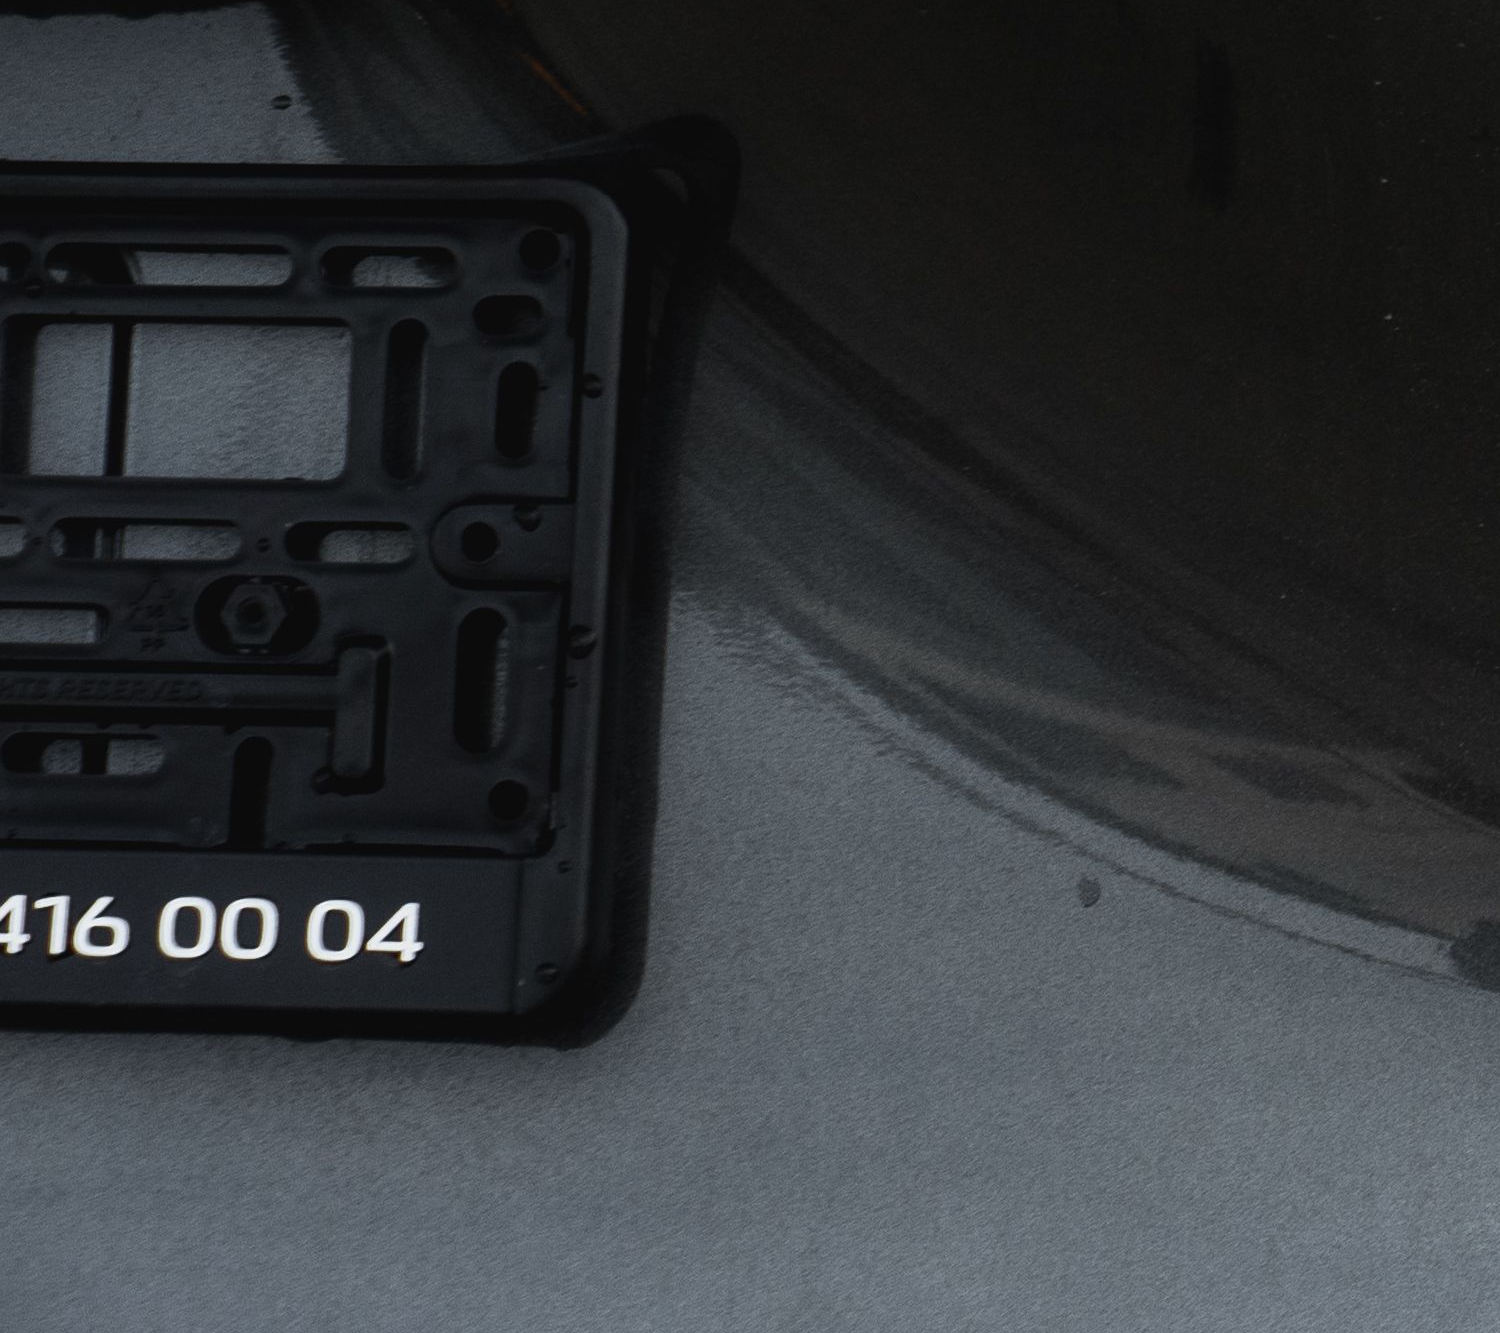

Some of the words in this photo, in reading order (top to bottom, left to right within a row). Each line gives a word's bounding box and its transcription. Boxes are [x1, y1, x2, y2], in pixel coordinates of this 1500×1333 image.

[53, 677, 203, 703] RESERVED
[157, 896, 279, 960] 00
[306, 899, 425, 963] 04
